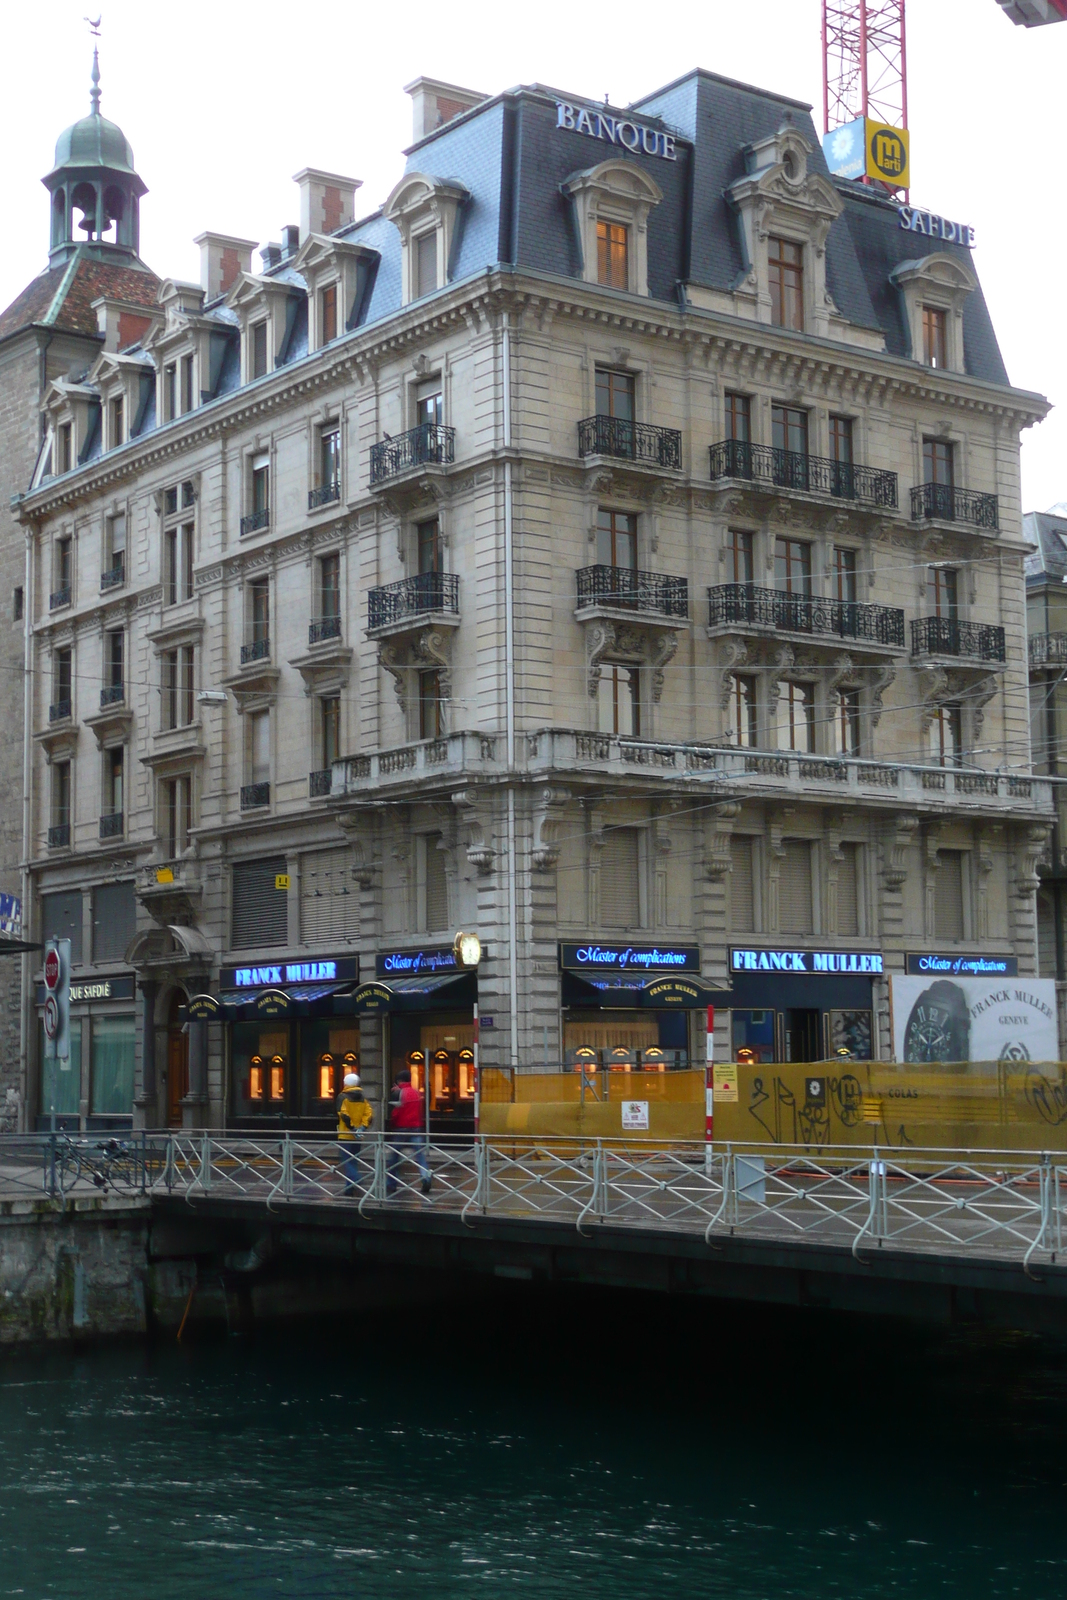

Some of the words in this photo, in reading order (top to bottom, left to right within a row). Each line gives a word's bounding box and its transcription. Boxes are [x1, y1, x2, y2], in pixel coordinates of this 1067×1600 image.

[555, 101, 677, 161] BANQUE
[576, 946, 618, 963] Master
[619, 948, 632, 968] of
[630, 949, 687, 968] complications
[733, 951, 807, 971] FRANCK
[813, 953, 883, 973] MULLER
[919, 955, 952, 970] Master
[952, 957, 963, 974] of
[961, 958, 1007, 974] complications
[235, 966, 282, 986] FRANCK
[286, 962, 337, 982] MULLER
[970, 989, 1011, 1019] FRANCK
[1014, 990, 1054, 1019] MULLER
[998, 1016, 1028, 1026] GENEVE
[888, 1088, 919, 1099] COLAS
